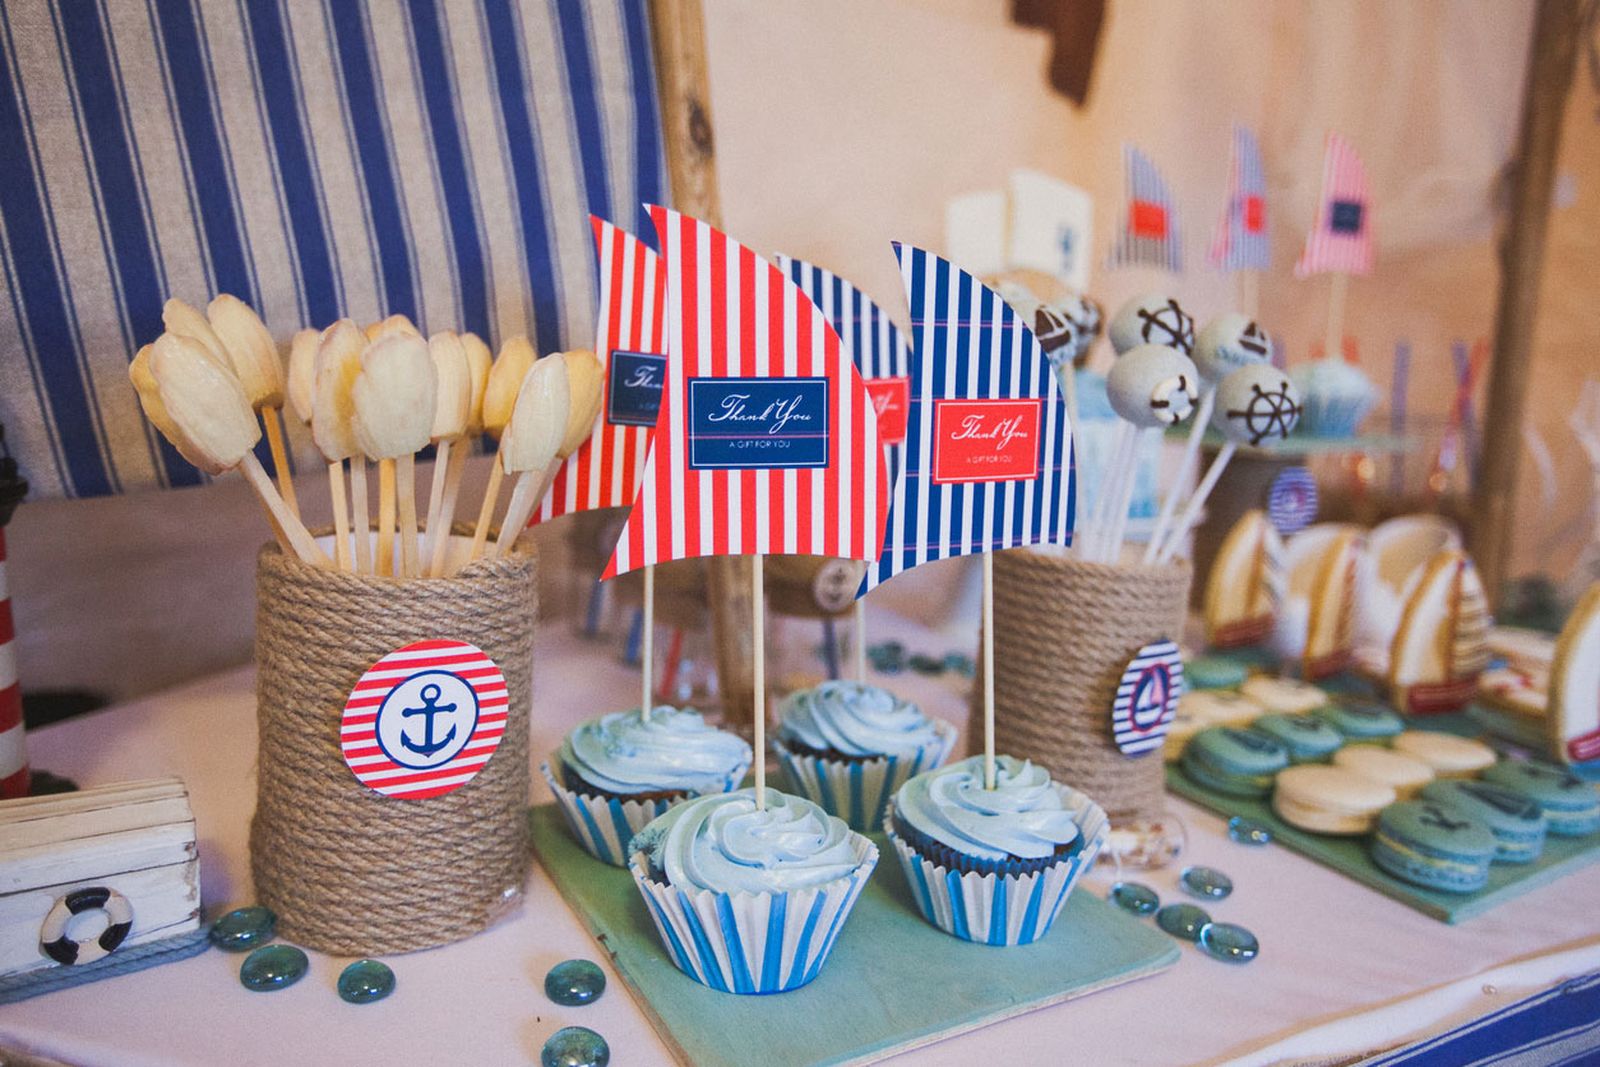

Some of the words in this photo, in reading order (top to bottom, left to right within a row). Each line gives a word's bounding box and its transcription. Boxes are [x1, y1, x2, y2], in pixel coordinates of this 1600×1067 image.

[708, 394, 775, 421] Thank
[768, 394, 811, 434] You
[737, 440, 754, 449] GIFT
[755, 440, 771, 448] FOR
[773, 440, 791, 448] YOU
[951, 415, 1002, 439] Thank
[996, 415, 1028, 450] You
